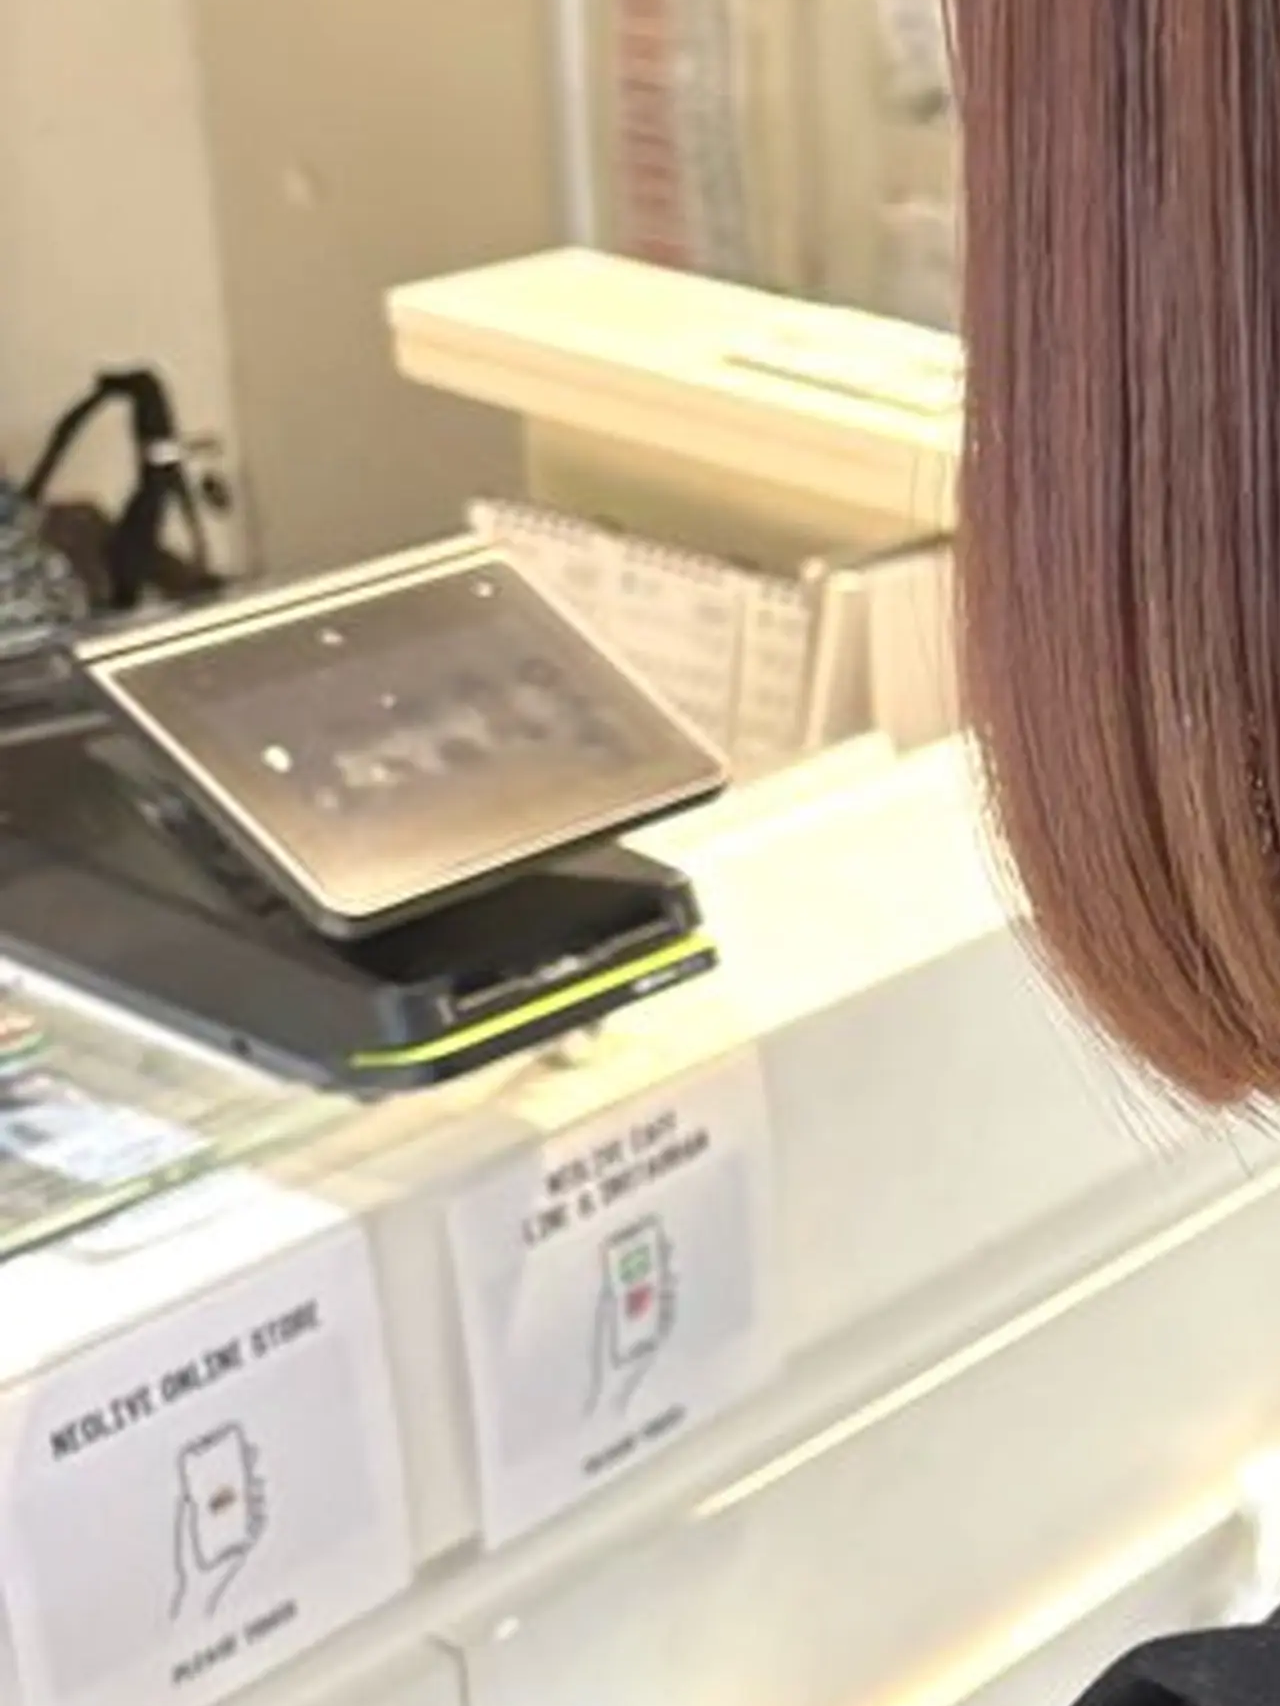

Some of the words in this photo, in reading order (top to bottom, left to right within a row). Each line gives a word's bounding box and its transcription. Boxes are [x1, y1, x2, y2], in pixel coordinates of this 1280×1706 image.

[50, 1385, 153, 1461] NEOLIVE
[161, 1337, 243, 1404] ONLINE
[251, 1298, 319, 1359] STORE
